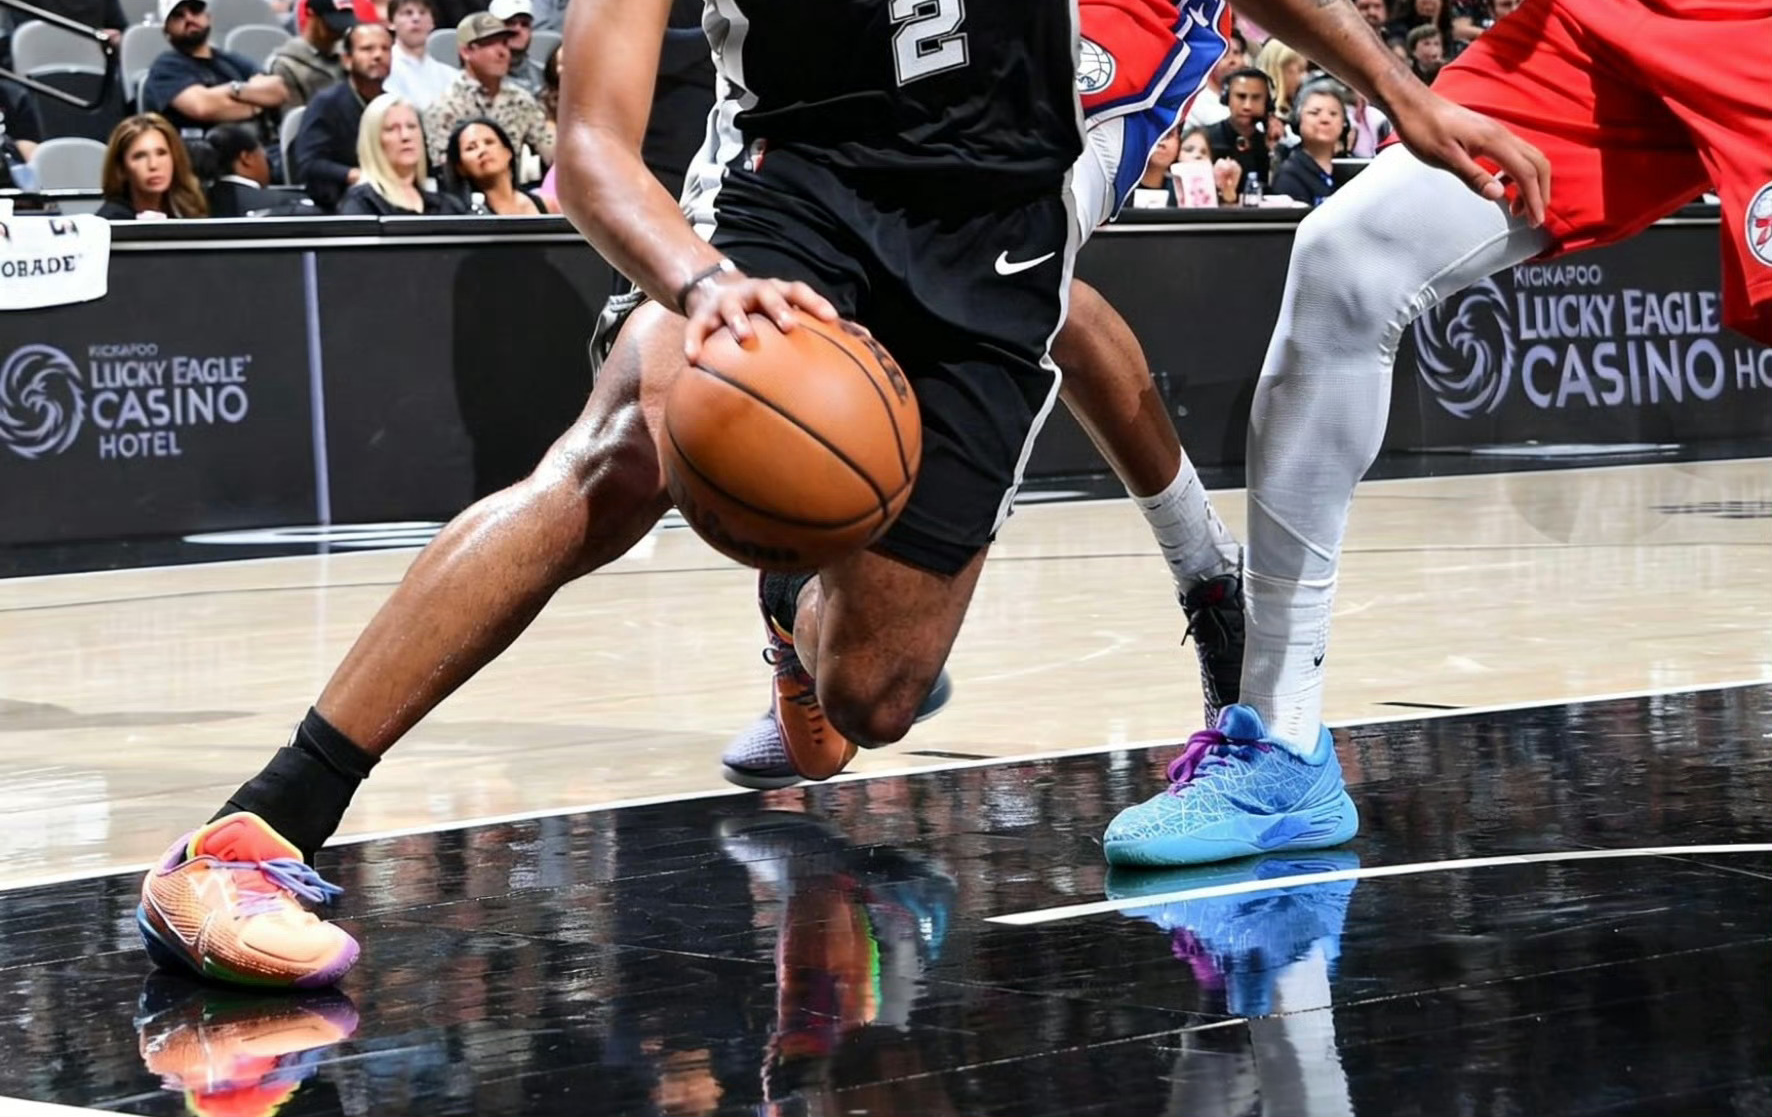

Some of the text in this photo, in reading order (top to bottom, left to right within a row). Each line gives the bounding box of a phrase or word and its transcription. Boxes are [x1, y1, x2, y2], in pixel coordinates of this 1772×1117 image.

[1513, 264, 1602, 288] KICKAPOO
[1517, 289, 1720, 340] LUCKY EAGLE
[88, 343, 158, 358] KICKAPOO
[90, 356, 247, 389] LUCKY EAGLE
[1521, 338, 1725, 409] CASINO
[91, 385, 249, 429] CASINO
[99, 431, 182, 459] HOTEL
